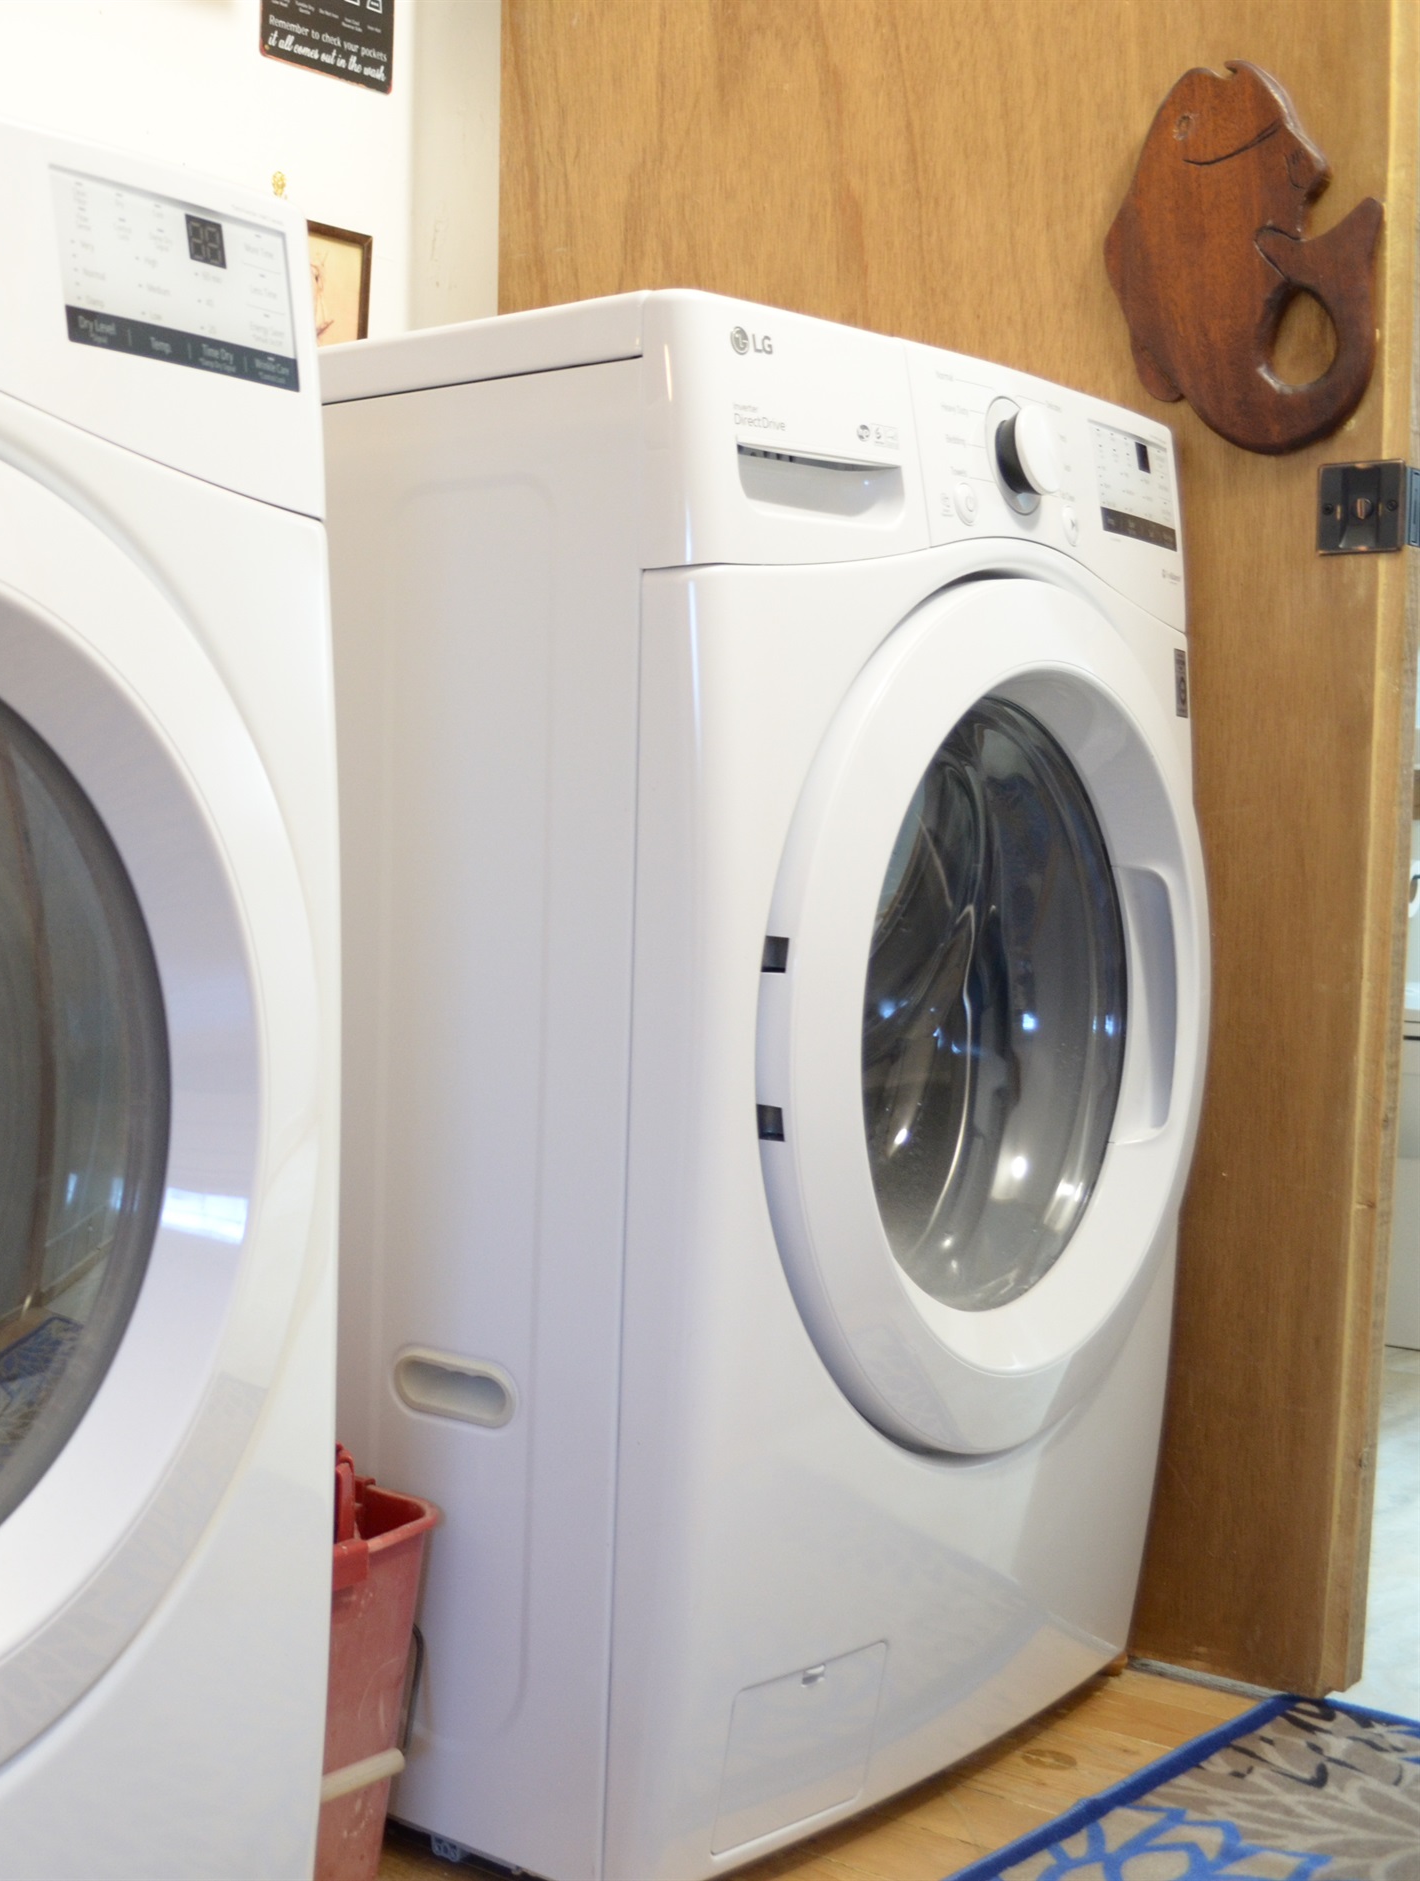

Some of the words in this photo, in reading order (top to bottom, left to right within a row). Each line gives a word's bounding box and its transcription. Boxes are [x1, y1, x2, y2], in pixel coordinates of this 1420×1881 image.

[269, 14, 309, 36] Remember
[311, 29, 320, 40] to
[321, 33, 342, 47] check
[343, 41, 359, 53] your
[360, 46, 387, 62] pockets
[268, 30, 278, 46] it
[278, 34, 295, 52] all
[294, 44, 319, 60] comes
[320, 49, 337, 65] out
[336, 55, 347, 68] in
[348, 55, 362, 73] the
[363, 65, 386, 81] wash
[78, 315, 94, 337] Dry
[94, 319, 117, 336] Level
[201, 343, 219, 359] Time
[219, 348, 234, 365] Dry
[752, 333, 773, 355] LG
